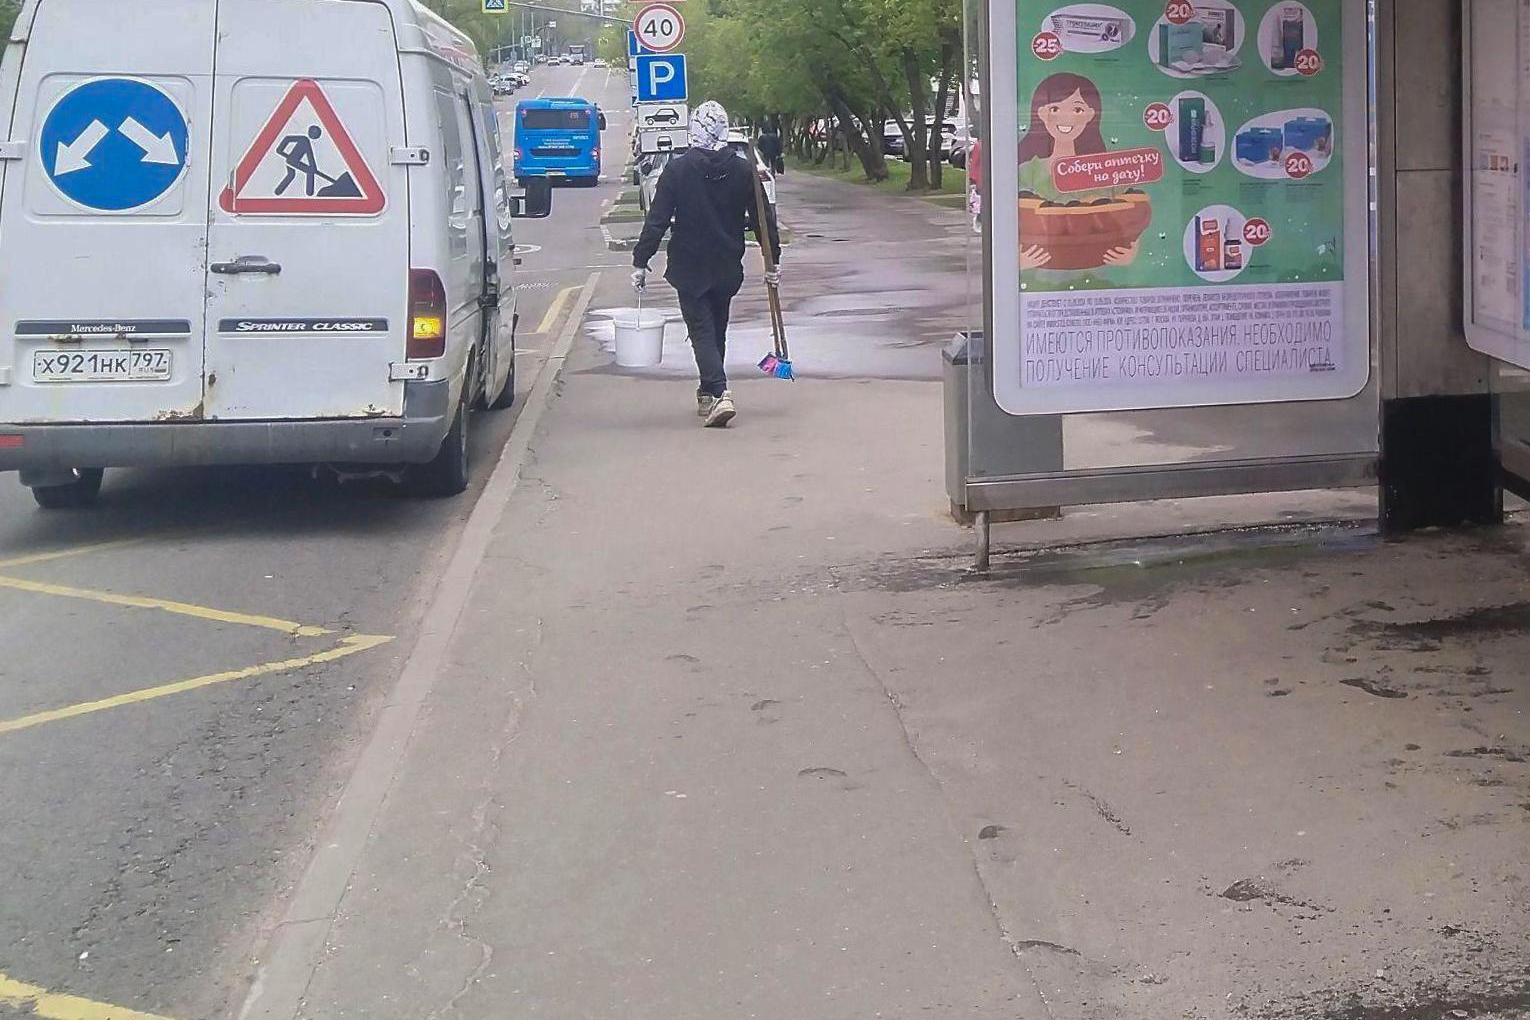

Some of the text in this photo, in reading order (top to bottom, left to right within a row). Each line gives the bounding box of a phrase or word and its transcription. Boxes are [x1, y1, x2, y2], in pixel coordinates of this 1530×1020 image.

[644, 19, 673, 37] 40
[650, 61, 675, 95] P
[1057, 151, 1159, 176] Собери аптечку
[1111, 164, 1145, 185] дачу!
[71, 324, 136, 333] Mercedes-Benz
[236, 321, 373, 331] SPRINTER CLASSIC
[1025, 320, 1332, 355] ИМЕЮТСЯ ПРОТИВОПОКАЗАНИЯ. НЕОБХОДИМО
[132, 352, 164, 367] 797
[1025, 346, 1331, 382] ПОЛУЧЕНИЕ КОНСУЛЬТАЦИИ СПЕЦИАЛИСТА
